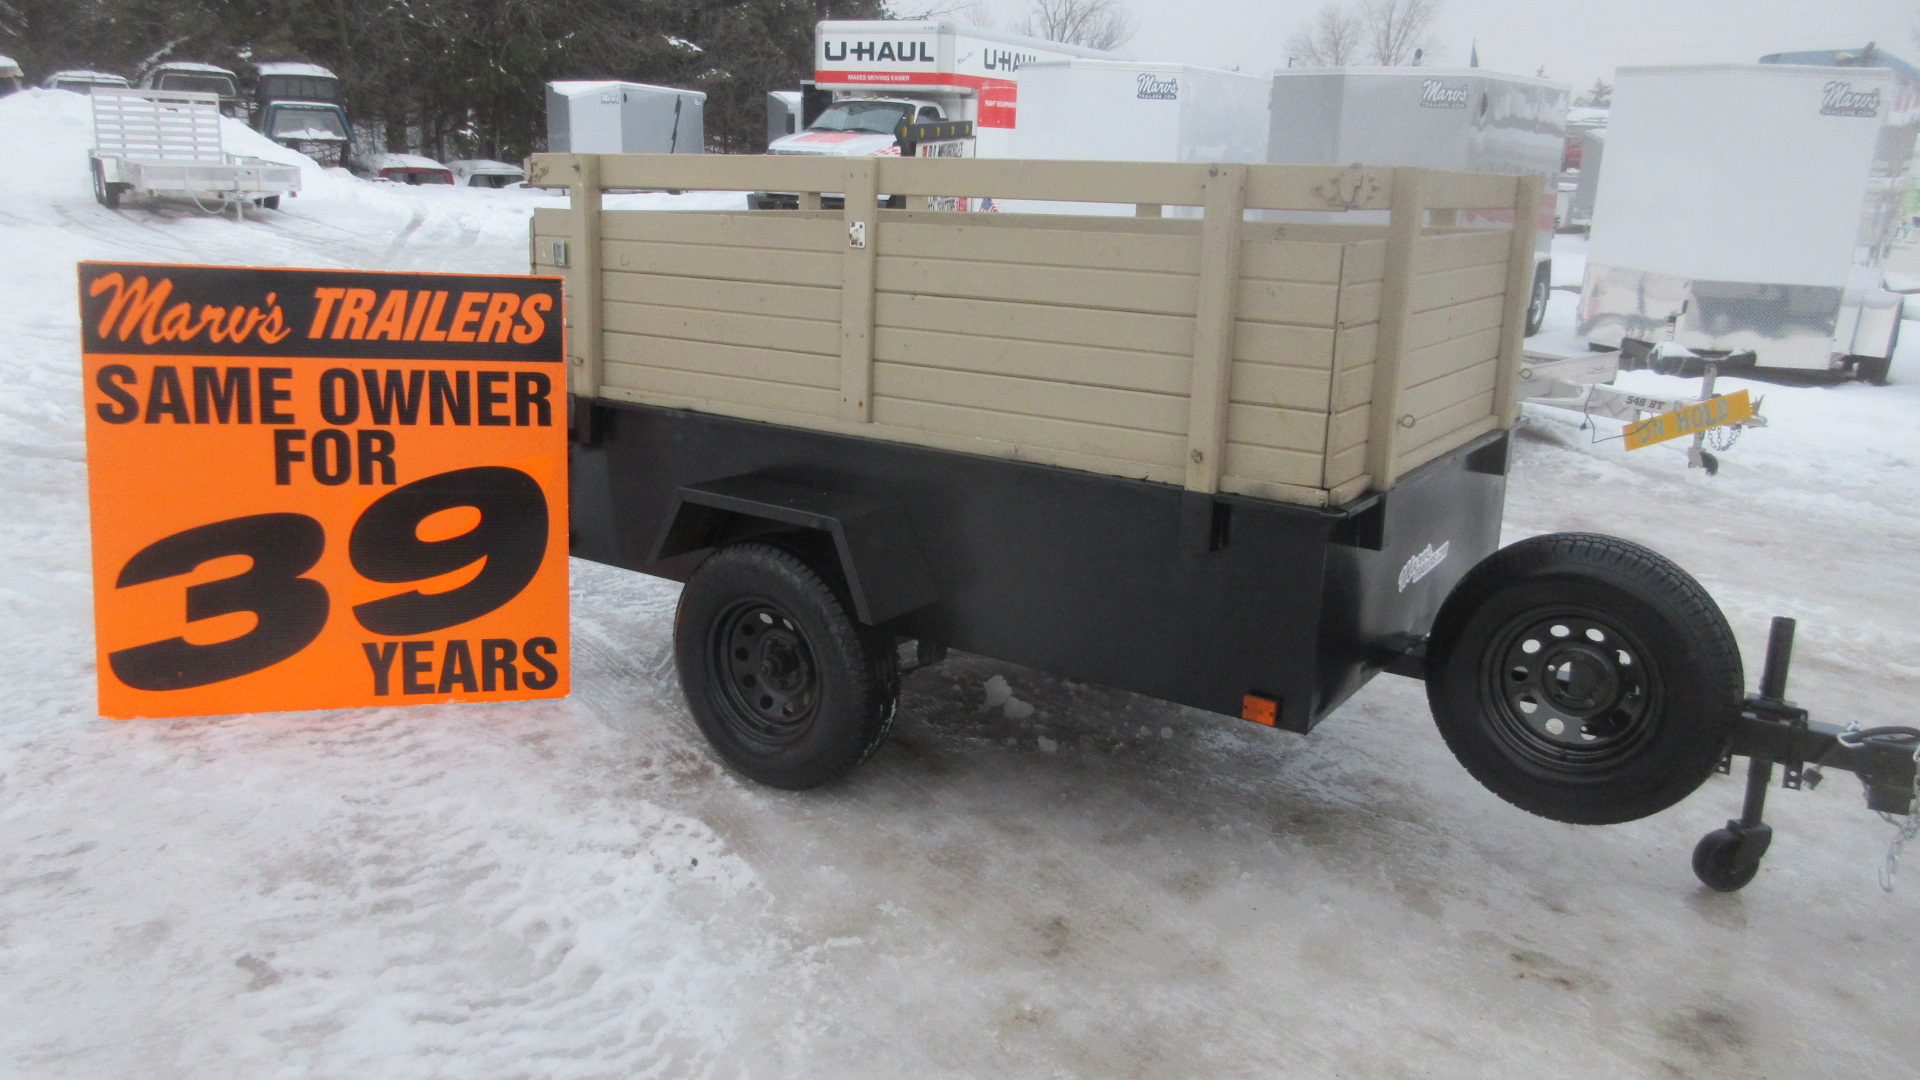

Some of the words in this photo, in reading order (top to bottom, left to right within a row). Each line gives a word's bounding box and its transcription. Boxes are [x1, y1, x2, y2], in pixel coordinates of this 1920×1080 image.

[824, 41, 935, 62] U-HAUL
[1137, 73, 1179, 95] Marv's
[1422, 79, 1468, 102] Marv's
[1823, 80, 1881, 110] Marv's
[90, 272, 292, 345] Marv's
[308, 287, 553, 345] TRAILERS
[95, 364, 296, 425] SAME
[319, 367, 553, 427] OWNER
[1636, 417, 1665, 443] ON
[1675, 398, 1730, 433] HOLD
[274, 429, 398, 486] FOR
[108, 465, 549, 692] 39
[362, 637, 559, 697] YEARS
